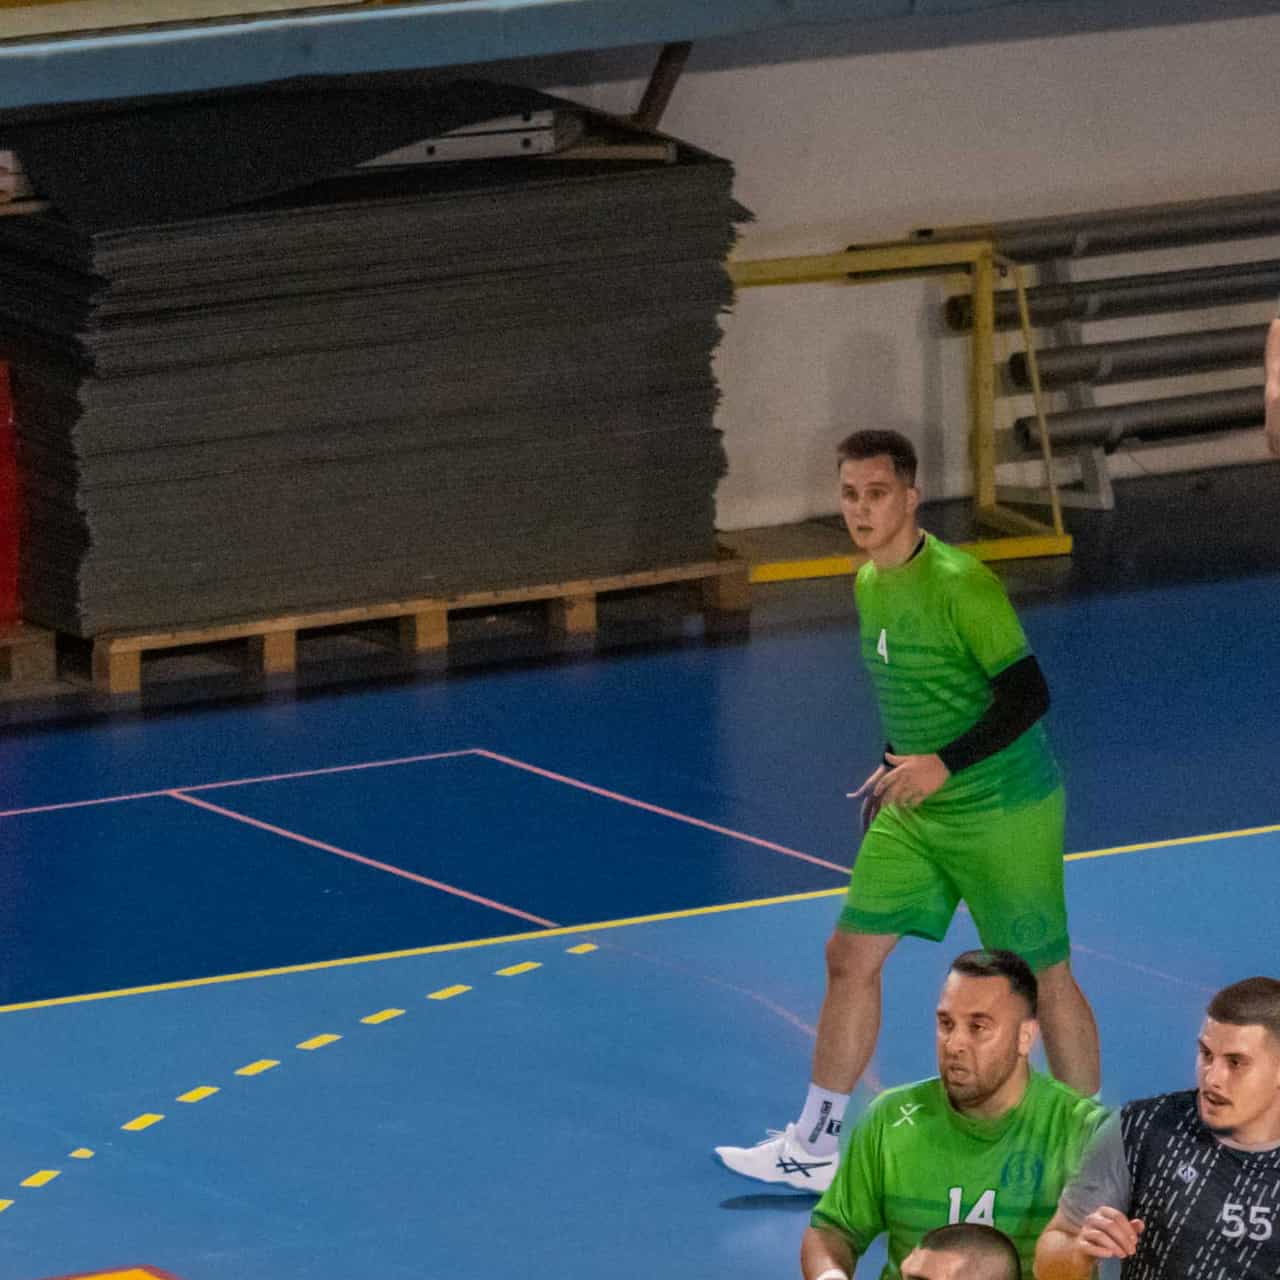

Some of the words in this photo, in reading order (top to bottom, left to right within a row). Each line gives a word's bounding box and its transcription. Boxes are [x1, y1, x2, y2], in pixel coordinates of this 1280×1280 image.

[876, 628, 889, 665] 4
[948, 1187, 996, 1227] 14
[1221, 1203, 1272, 1241] 55
